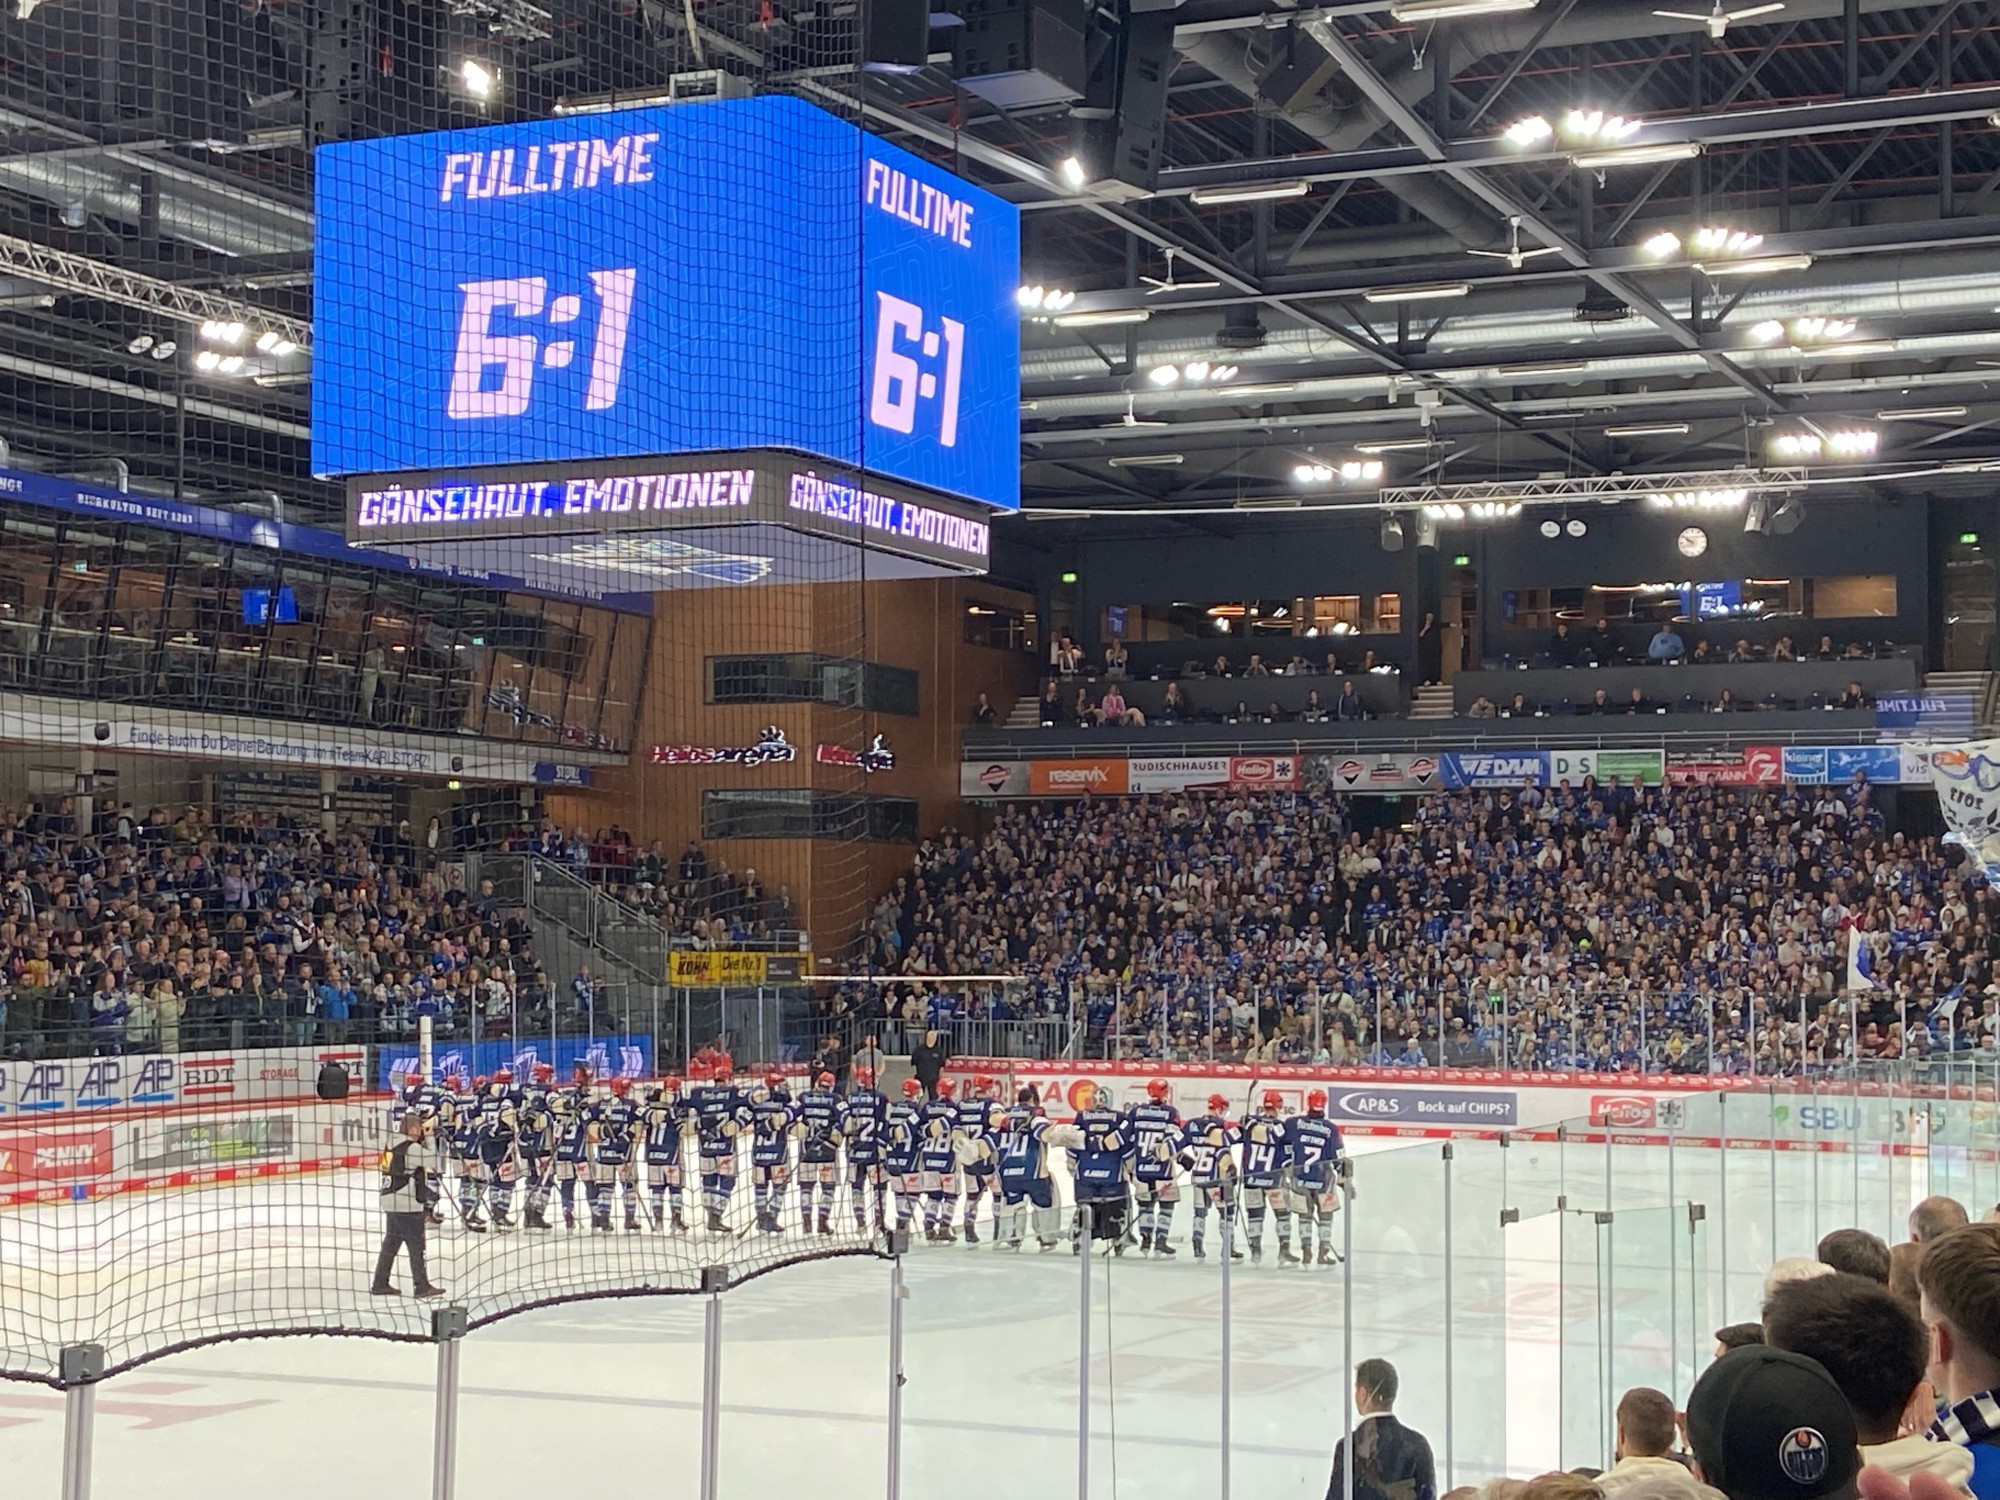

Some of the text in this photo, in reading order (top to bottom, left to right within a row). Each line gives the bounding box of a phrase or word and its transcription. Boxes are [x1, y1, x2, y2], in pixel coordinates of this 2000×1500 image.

[441, 132, 660, 202] FULLTIME
[866, 158, 974, 248] FULLTIME
[447, 268, 637, 419] 6:1
[870, 291, 965, 447] 6:1
[563, 469, 756, 515] EMOTIONEN
[77, 493, 143, 516] BIERKULTUR
[146, 506, 169, 520] SEIT
[900, 509, 990, 556] EMOTIONEN
[130, 727, 164, 746] Finde
[168, 732, 198, 749] auch
[202, 734, 218, 751] Du
[220, 735, 254, 753] Deine
[1049, 766, 1111, 788] reservix
[1132, 761, 1228, 771] RUDISCHHAUSER
[1236, 763, 1272, 776] Helios
[1459, 758, 1541, 776] WEDAM
[722, 956, 740, 971] Die
[184, 1067, 235, 1086] BDT
[259, 1067, 299, 1080] STORAGE
[1357, 1098, 1400, 1113] AP&S
[1417, 1100, 1511, 1116] Bock auf CHIPS?
[1597, 1102, 1653, 1119] Helios
[1799, 1105, 1862, 1131] SBU
[1248, 1143, 1276, 1173] 14
[1303, 1145, 1322, 1174] 7
